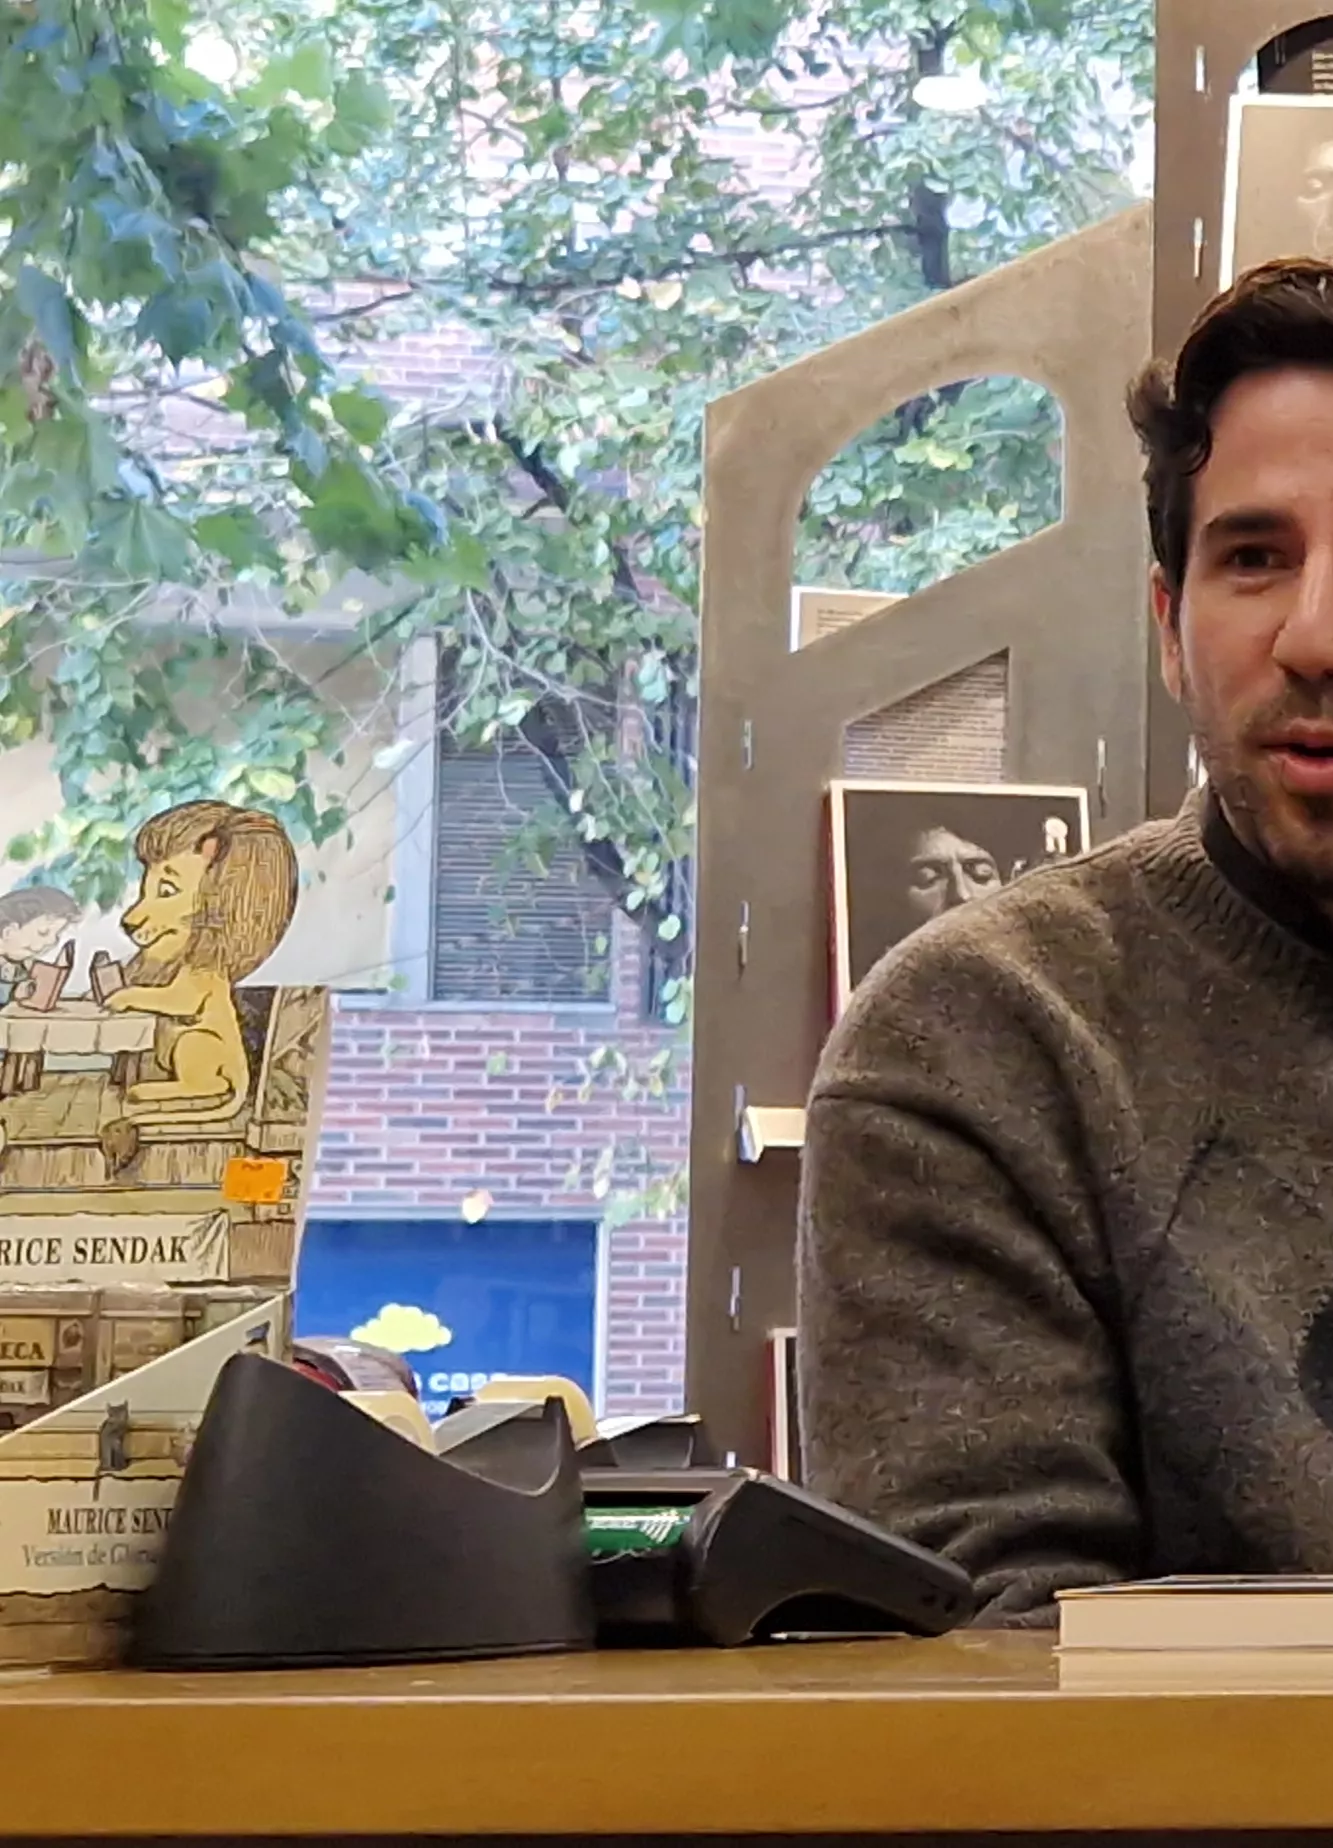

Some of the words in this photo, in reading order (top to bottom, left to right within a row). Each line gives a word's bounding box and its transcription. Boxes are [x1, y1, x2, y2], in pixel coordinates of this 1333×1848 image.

[73, 1235, 190, 1264] SENDAK
[47, 1507, 127, 1535] MAURICE
[131, 1507, 175, 1534] SEN
